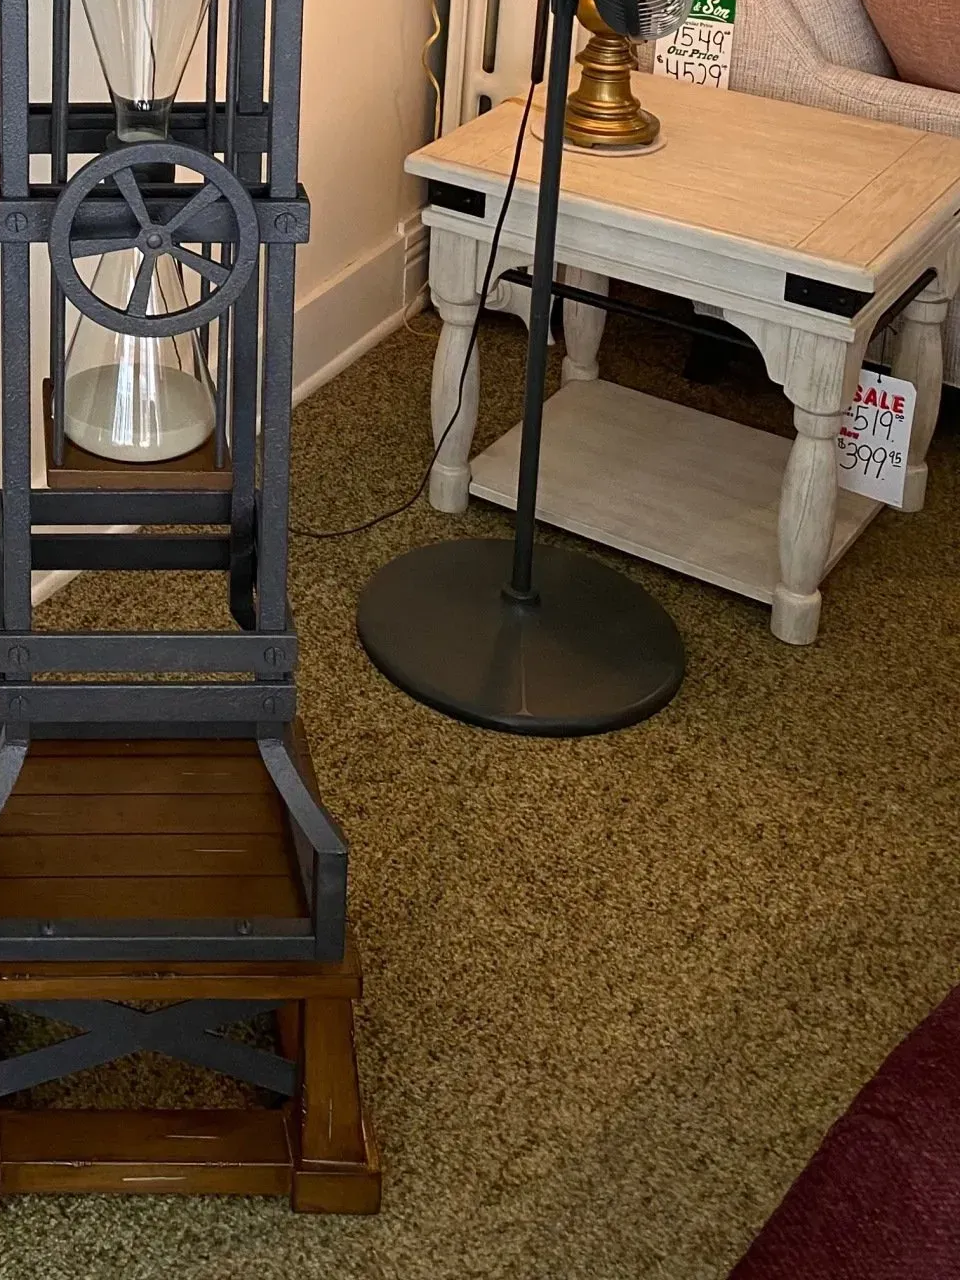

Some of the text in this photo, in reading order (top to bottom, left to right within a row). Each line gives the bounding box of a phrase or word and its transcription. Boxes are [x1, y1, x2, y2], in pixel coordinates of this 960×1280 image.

[693, 1, 702, 12] &
[667, 45, 720, 62] Our Price
[853, 384, 906, 415] SALE
